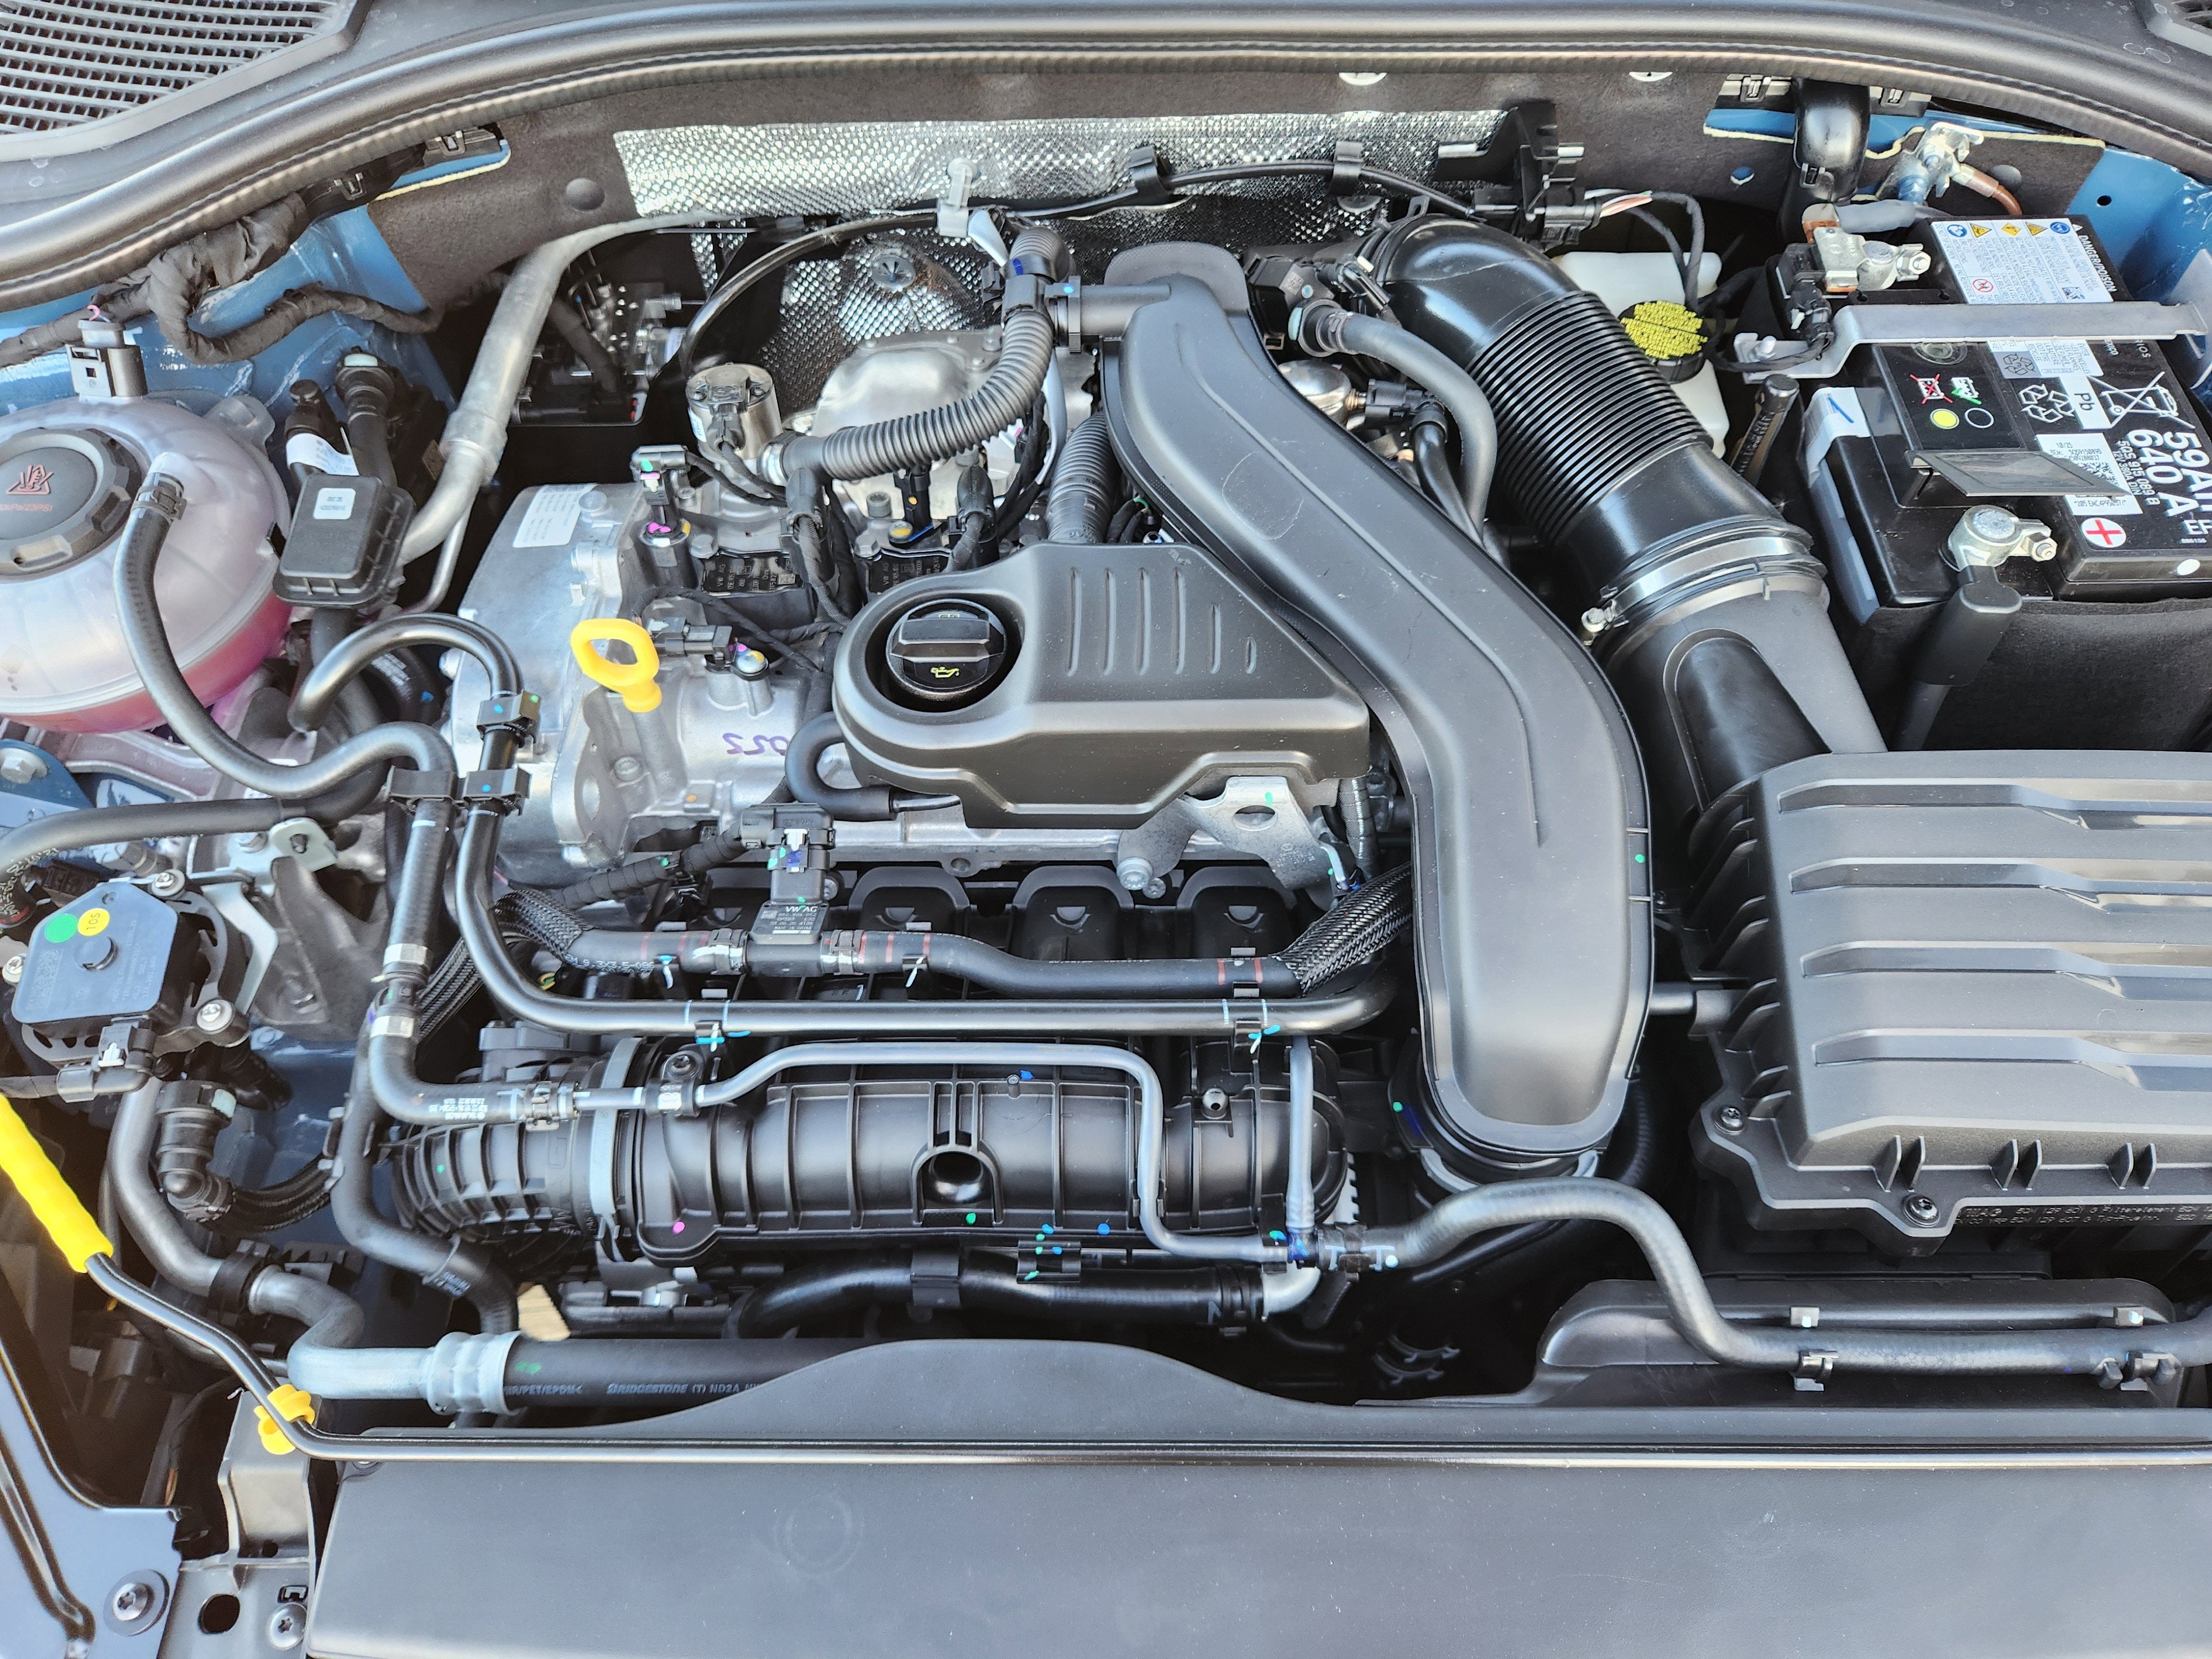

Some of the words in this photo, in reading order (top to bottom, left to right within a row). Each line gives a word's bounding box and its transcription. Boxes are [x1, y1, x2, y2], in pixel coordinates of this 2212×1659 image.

[2079, 235, 2117, 292] DANGER/POISON
[2074, 392, 2096, 411] Pb
[2116, 440, 2137, 459] 5QS
[2114, 451, 2125, 463] 12V
[2120, 463, 2135, 481] 380A
[2128, 482, 2143, 495] DIN
[2127, 429, 2183, 484] 640
[2158, 492, 2199, 517] A
[2129, 461, 2145, 477] 915
[2137, 478, 2156, 495] 089
[2146, 497, 2161, 505] B
[2183, 519, 2212, 535] EF
[608, 1383, 690, 1395] BRIDGESTONE
